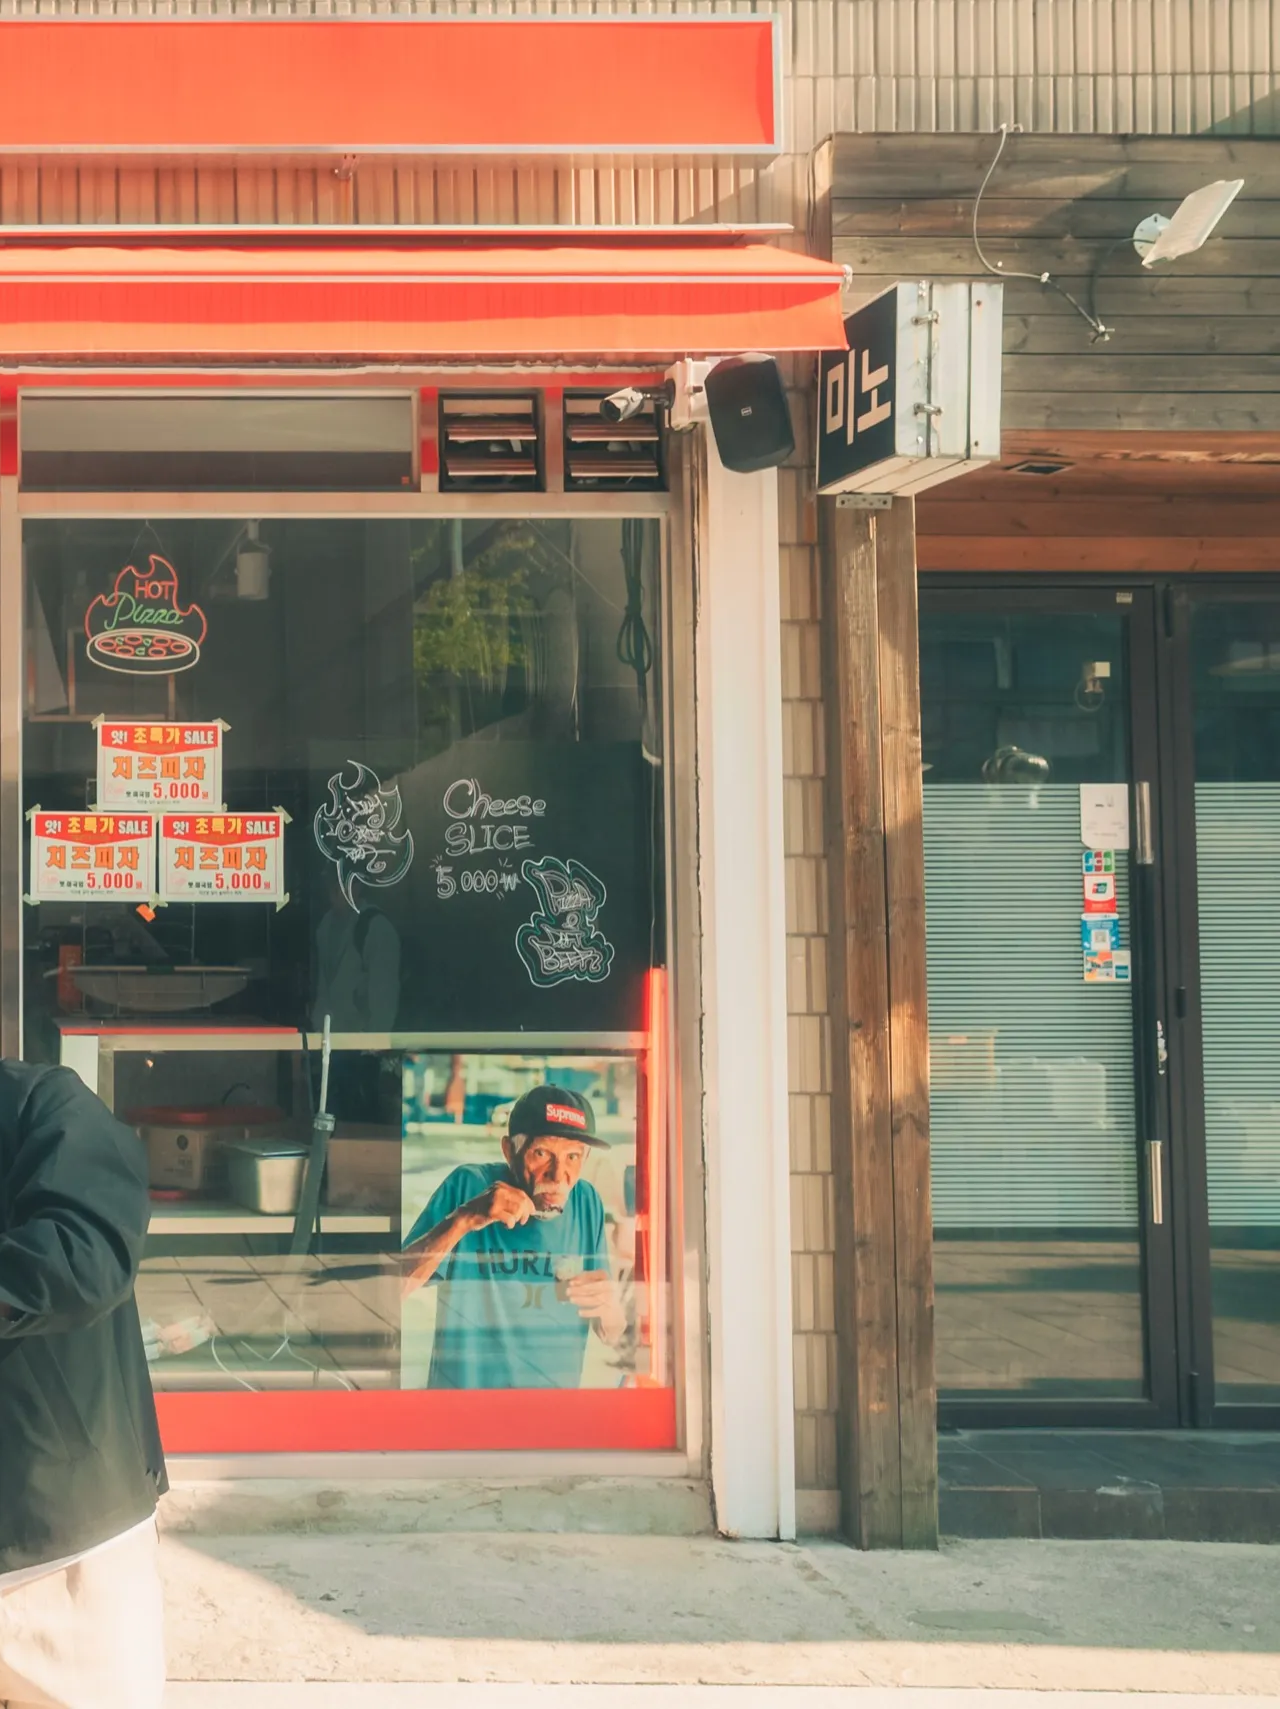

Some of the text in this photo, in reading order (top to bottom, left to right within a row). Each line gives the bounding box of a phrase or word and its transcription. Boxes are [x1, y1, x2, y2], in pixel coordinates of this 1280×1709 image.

[825, 348, 892, 446] 미노
[134, 579, 177, 600] HOT
[104, 591, 184, 631] Pizza
[183, 730, 215, 745] SALE
[111, 755, 206, 780] 치즈피자
[442, 778, 547, 820] Cheese
[118, 819, 149, 835] SALE
[246, 820, 276, 835] SALE
[444, 822, 535, 856] SLICE
[45, 845, 140, 871] 치즈피자
[173, 846, 268, 871] 치즈피자
